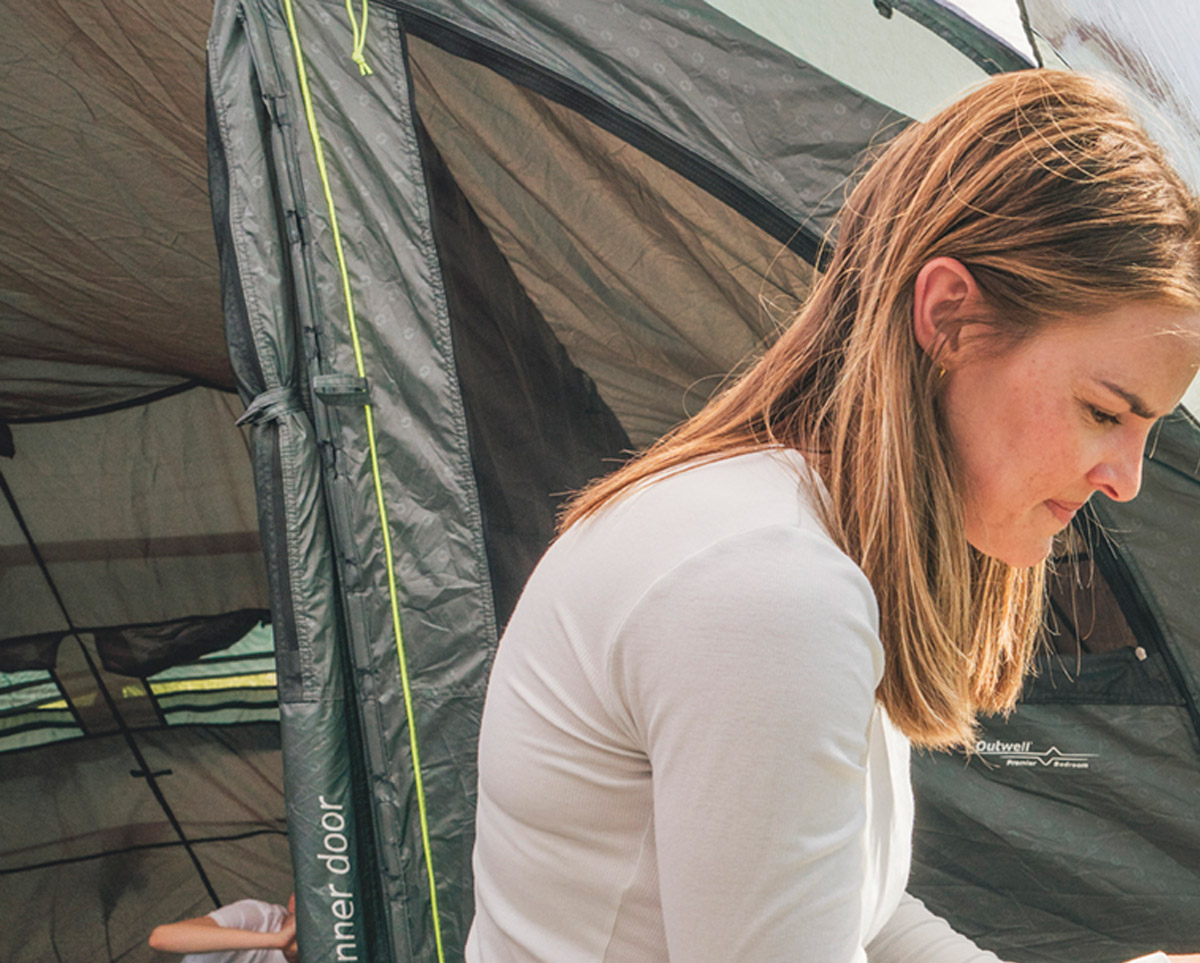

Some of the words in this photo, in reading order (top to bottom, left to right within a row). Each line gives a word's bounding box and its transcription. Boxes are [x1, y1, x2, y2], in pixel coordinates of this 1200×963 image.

[976, 740, 1032, 752] Outwell
[1006, 759, 1037, 767] Premier
[317, 795, 350, 875] door
